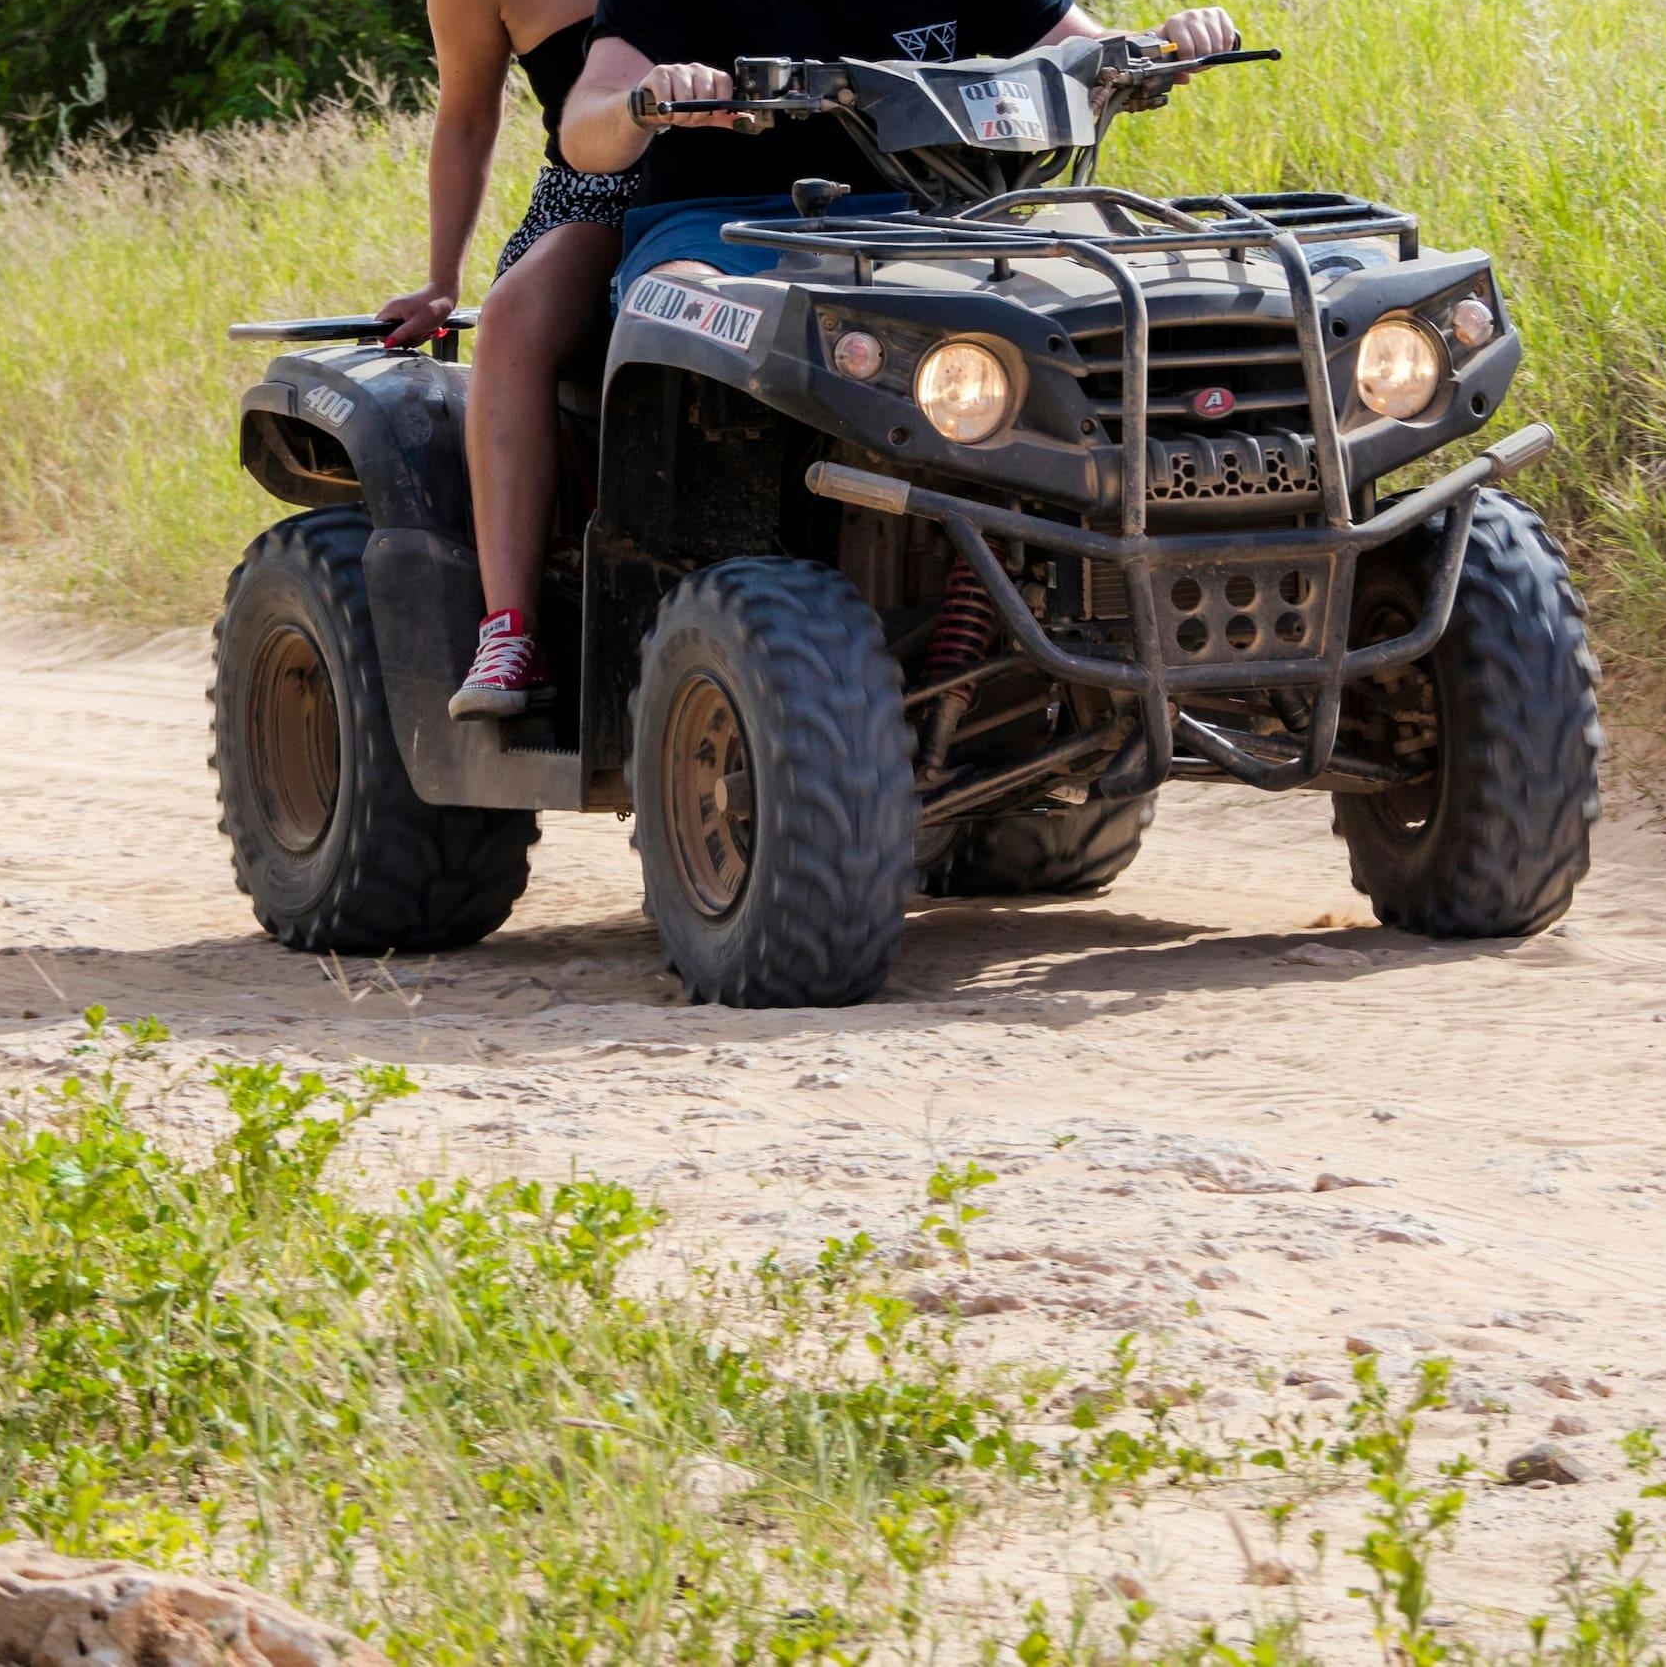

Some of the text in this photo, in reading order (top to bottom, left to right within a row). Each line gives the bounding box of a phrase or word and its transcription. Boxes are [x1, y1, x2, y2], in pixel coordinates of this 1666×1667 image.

[965, 81, 1030, 100] QUAD
[981, 119, 1043, 139] ZONE
[633, 280, 756, 344] QUAD ZONE
[304, 384, 356, 428] 400
[1204, 391, 1223, 408] A
